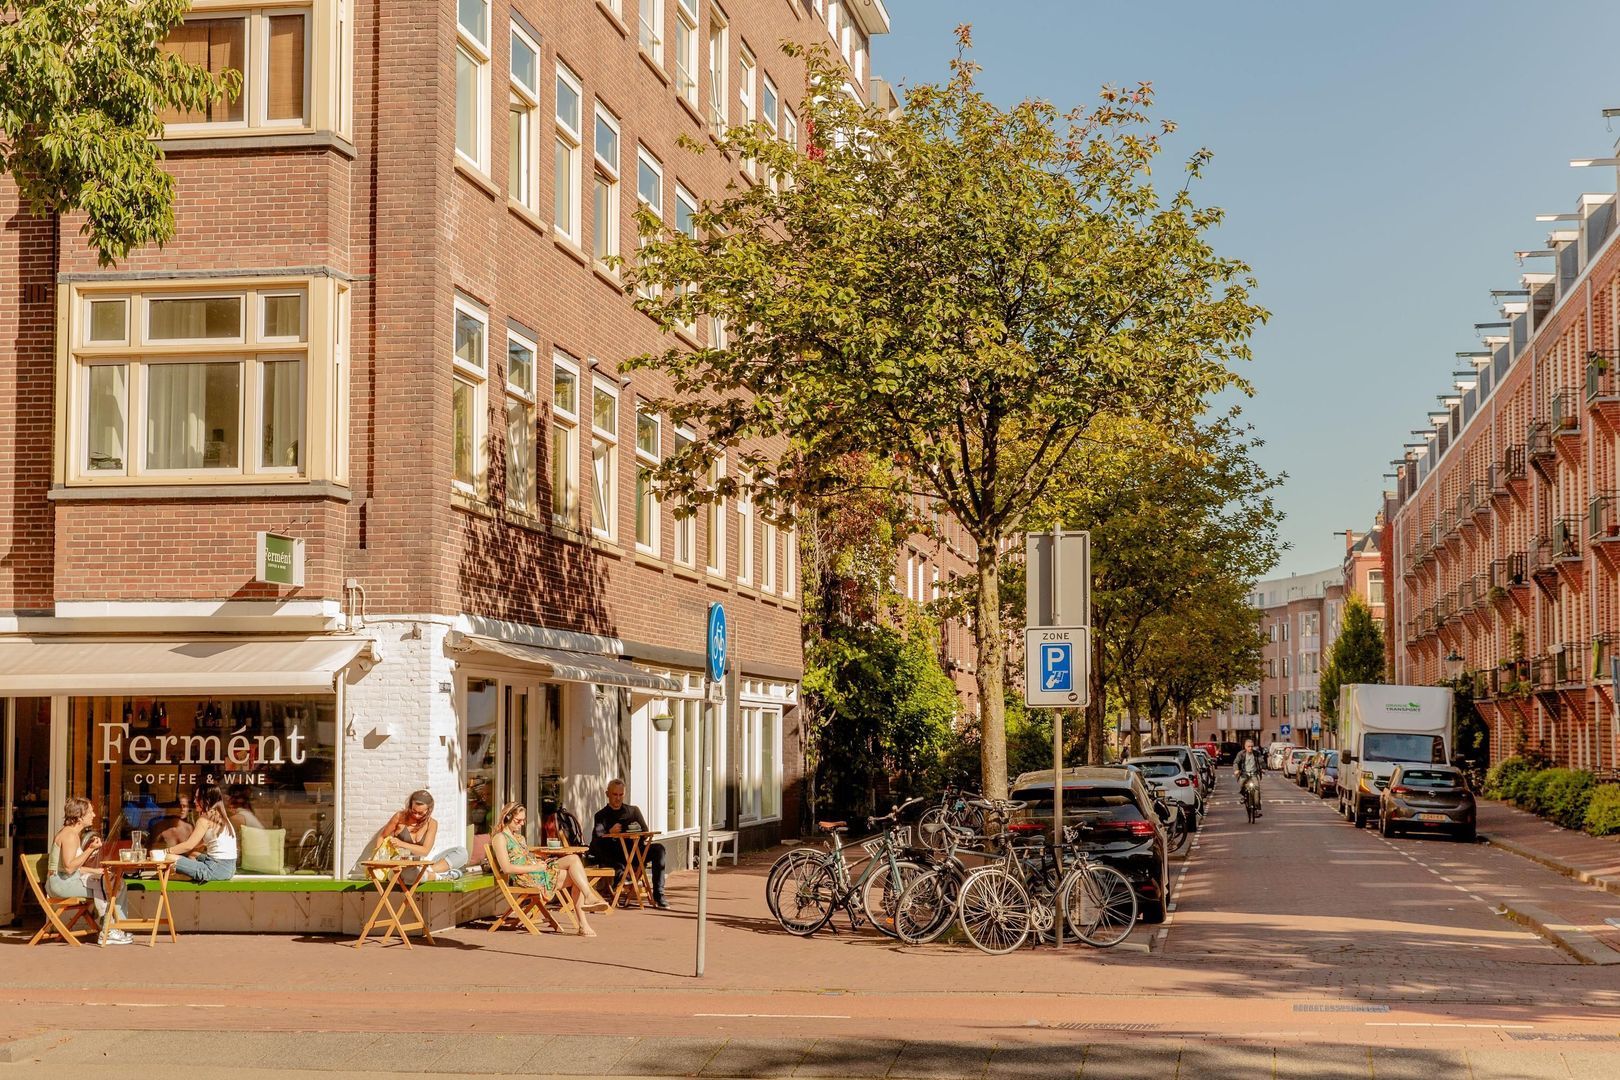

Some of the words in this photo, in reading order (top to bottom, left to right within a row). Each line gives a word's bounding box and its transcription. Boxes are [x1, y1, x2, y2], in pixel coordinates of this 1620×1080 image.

[1048, 648, 1064, 671] P
[98, 723, 305, 764] Fermént
[134, 773, 196, 785] COFFEE
[206, 774, 214, 785] &
[224, 774, 265, 785] WINE
